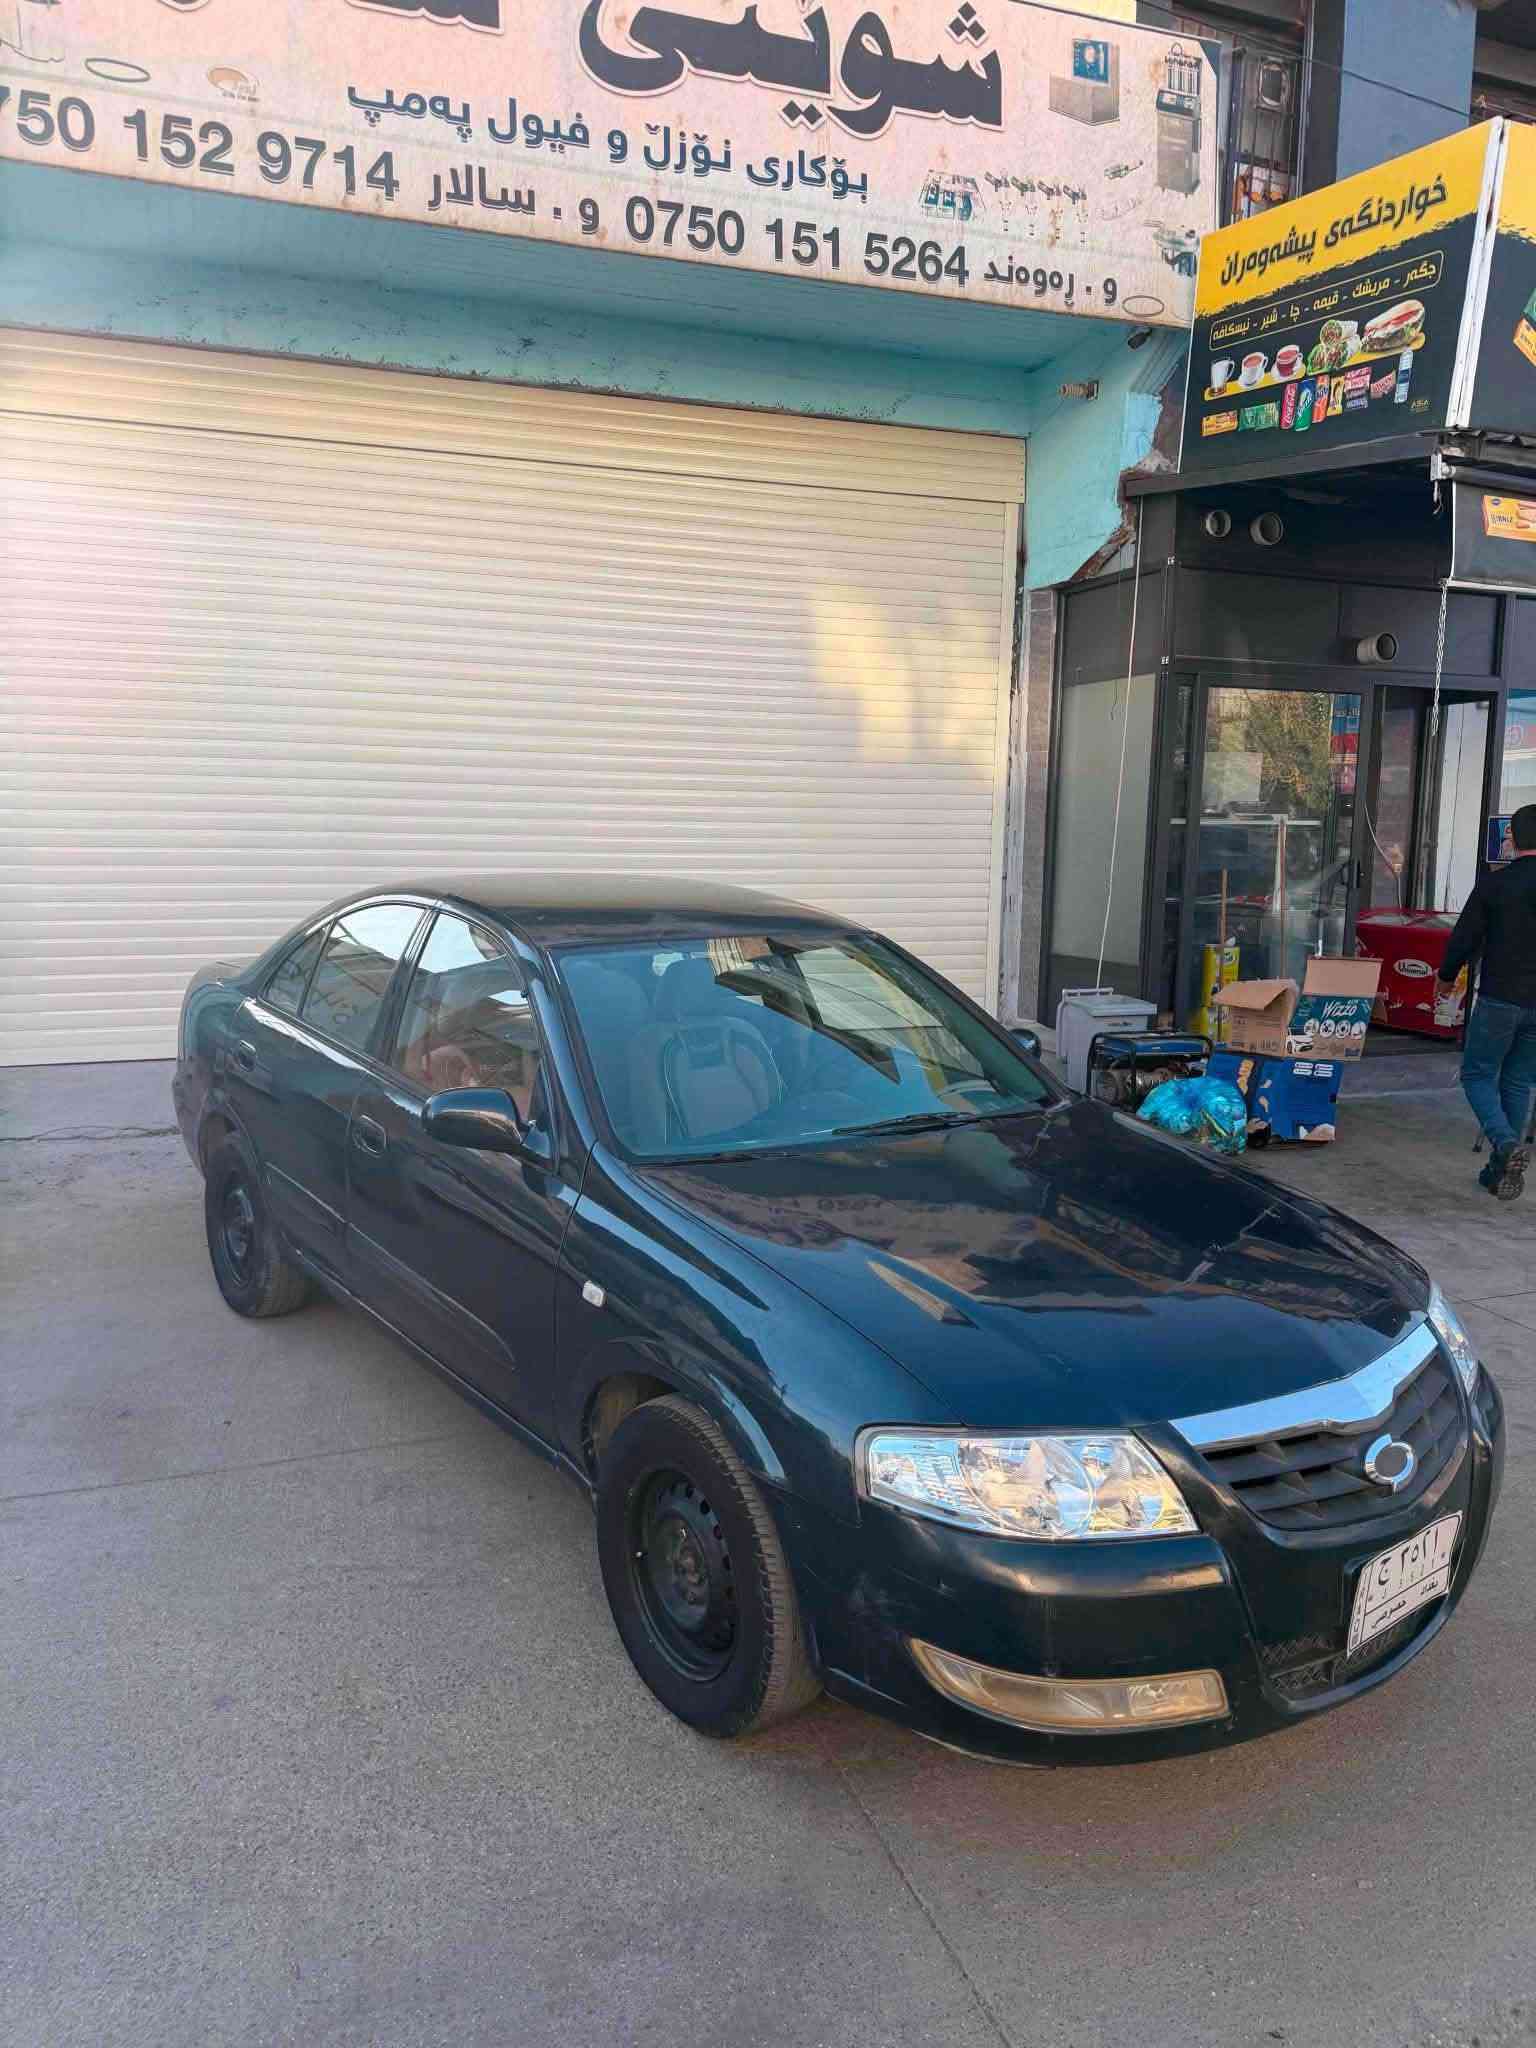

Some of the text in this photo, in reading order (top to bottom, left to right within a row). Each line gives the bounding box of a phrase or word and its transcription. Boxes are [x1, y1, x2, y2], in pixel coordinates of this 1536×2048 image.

[123, 109, 234, 176] 152
[347, 86, 472, 142] پەمپ
[257, 131, 399, 202] 9714
[607, 129, 628, 163] و
[428, 164, 536, 215] سالار
[626, 196, 745, 255] 0750
[765, 218, 841, 270] 151
[864, 232, 969, 287] 5264
